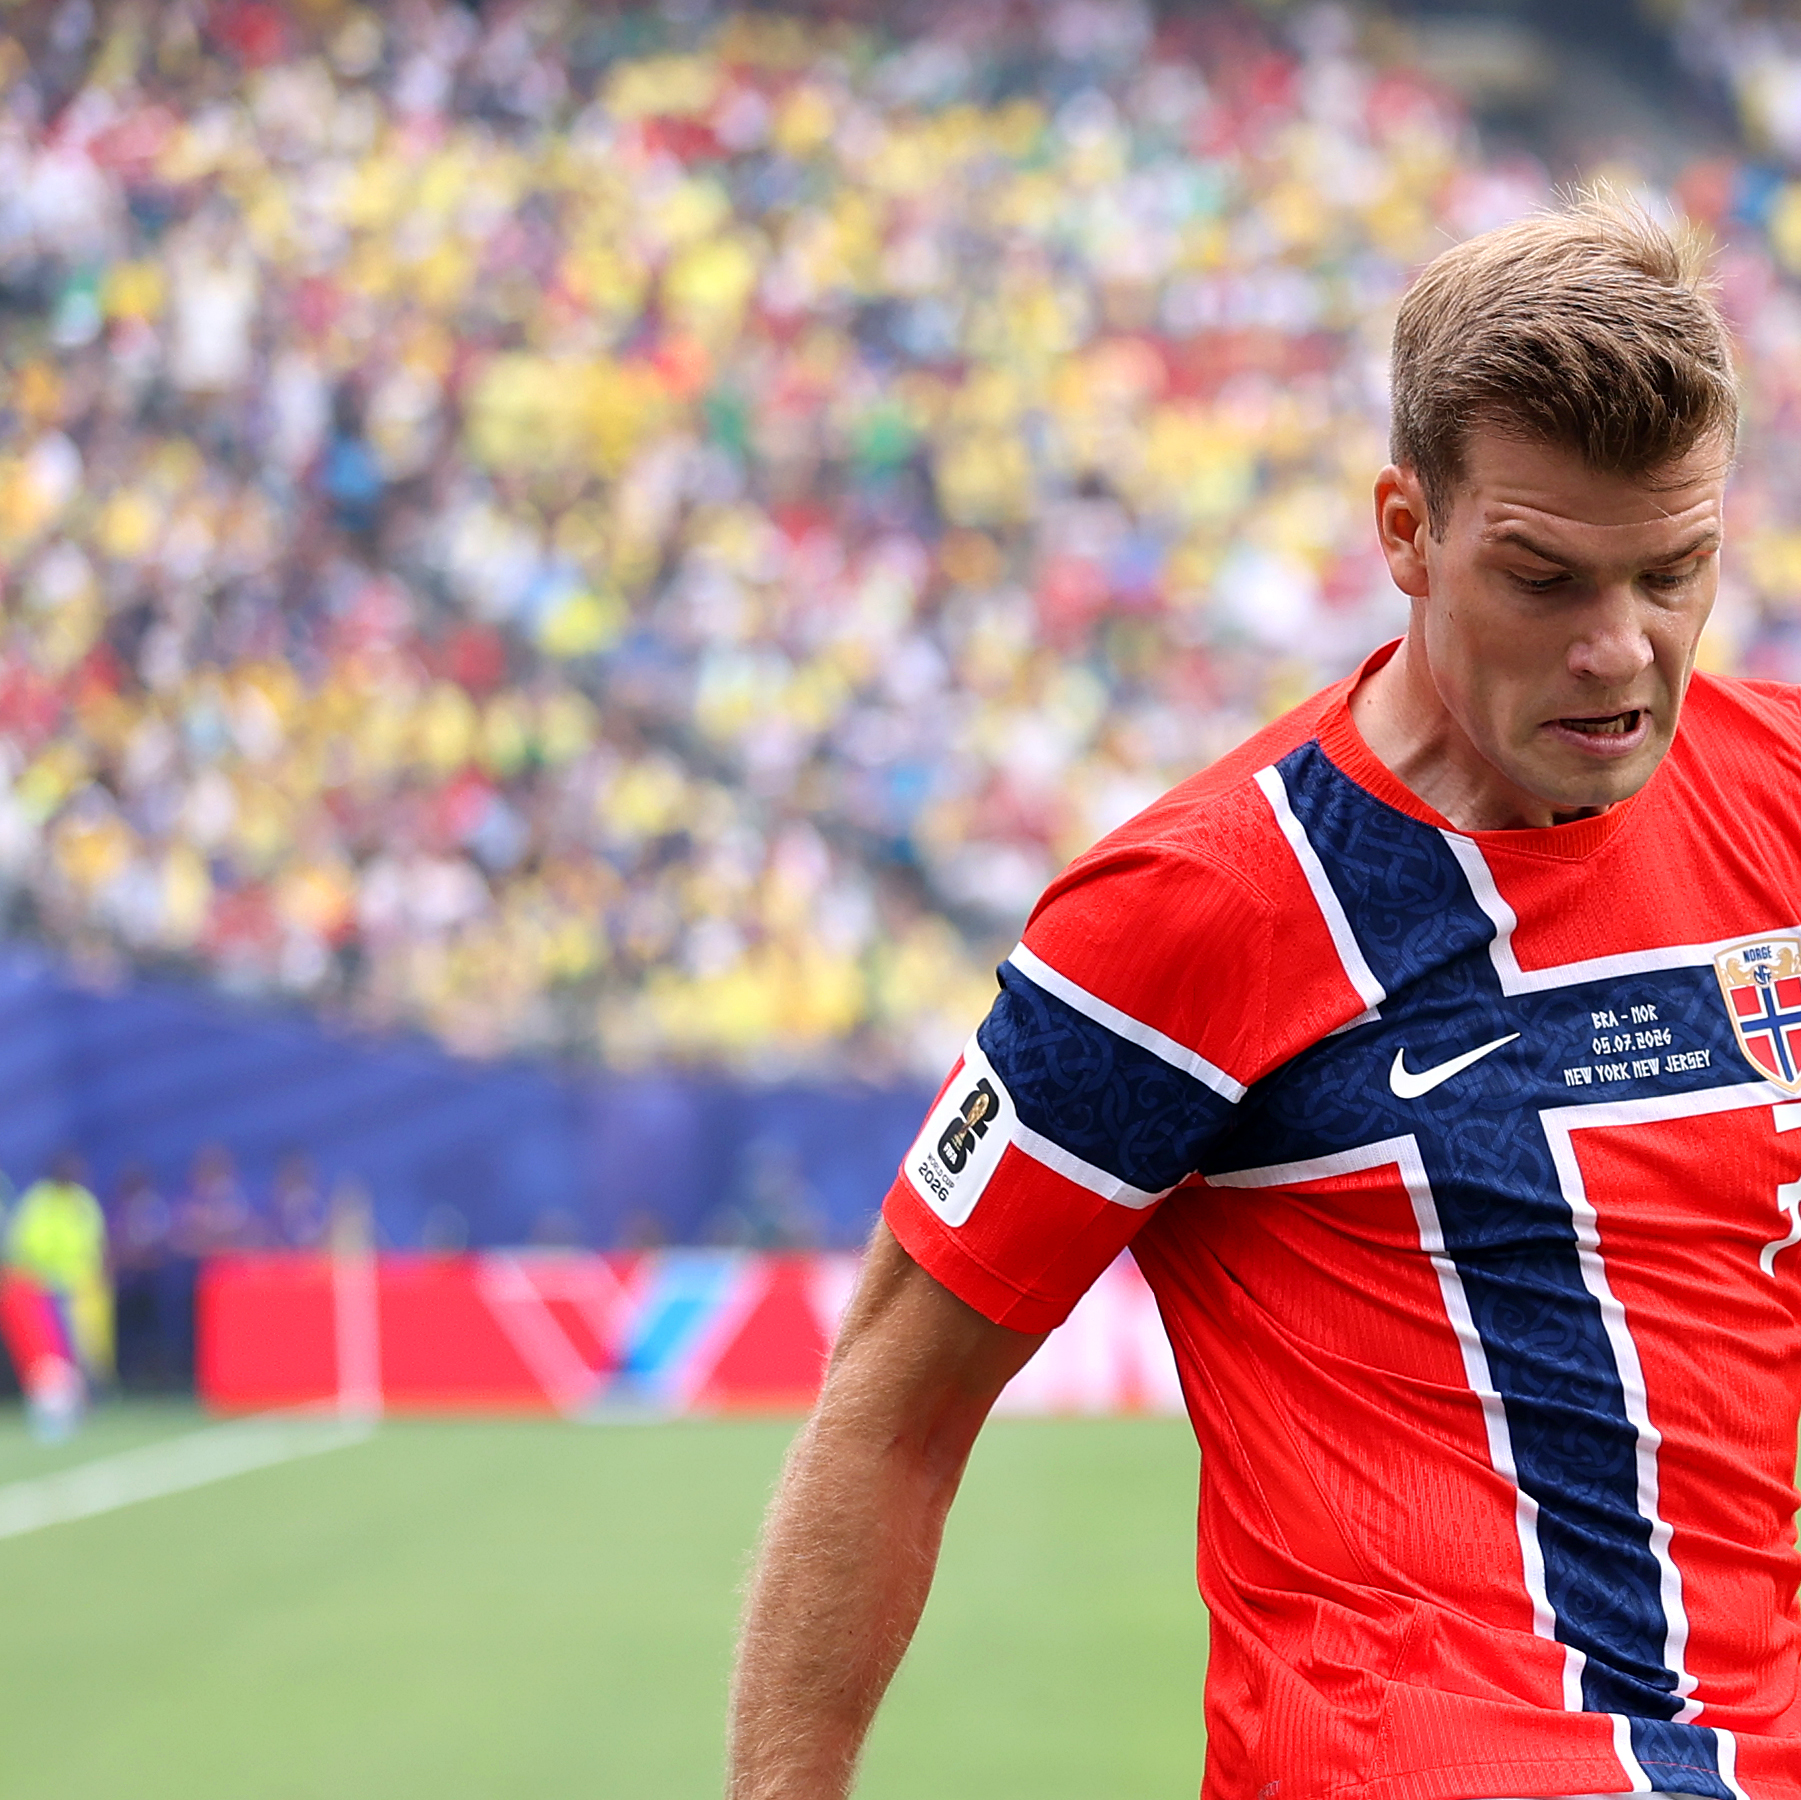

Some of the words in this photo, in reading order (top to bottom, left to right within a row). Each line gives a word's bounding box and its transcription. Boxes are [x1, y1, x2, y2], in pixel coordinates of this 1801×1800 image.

[1743, 945, 1773, 963] NORGE
[1591, 1010, 1619, 1029] BRA
[1630, 1004, 1659, 1024] NOR
[1592, 1028, 1672, 1055] 05.07.2026
[1563, 1066, 1593, 1087] NEW
[1594, 1062, 1631, 1083] YORK
[1632, 1058, 1660, 1079] NEW
[1665, 1049, 1711, 1073] JERSEY
[942, 1141, 958, 1165] FIFA
[918, 1162, 949, 1202] 2026
[927, 1151, 943, 1177] WORLD
[942, 1174, 955, 1189] CUP
